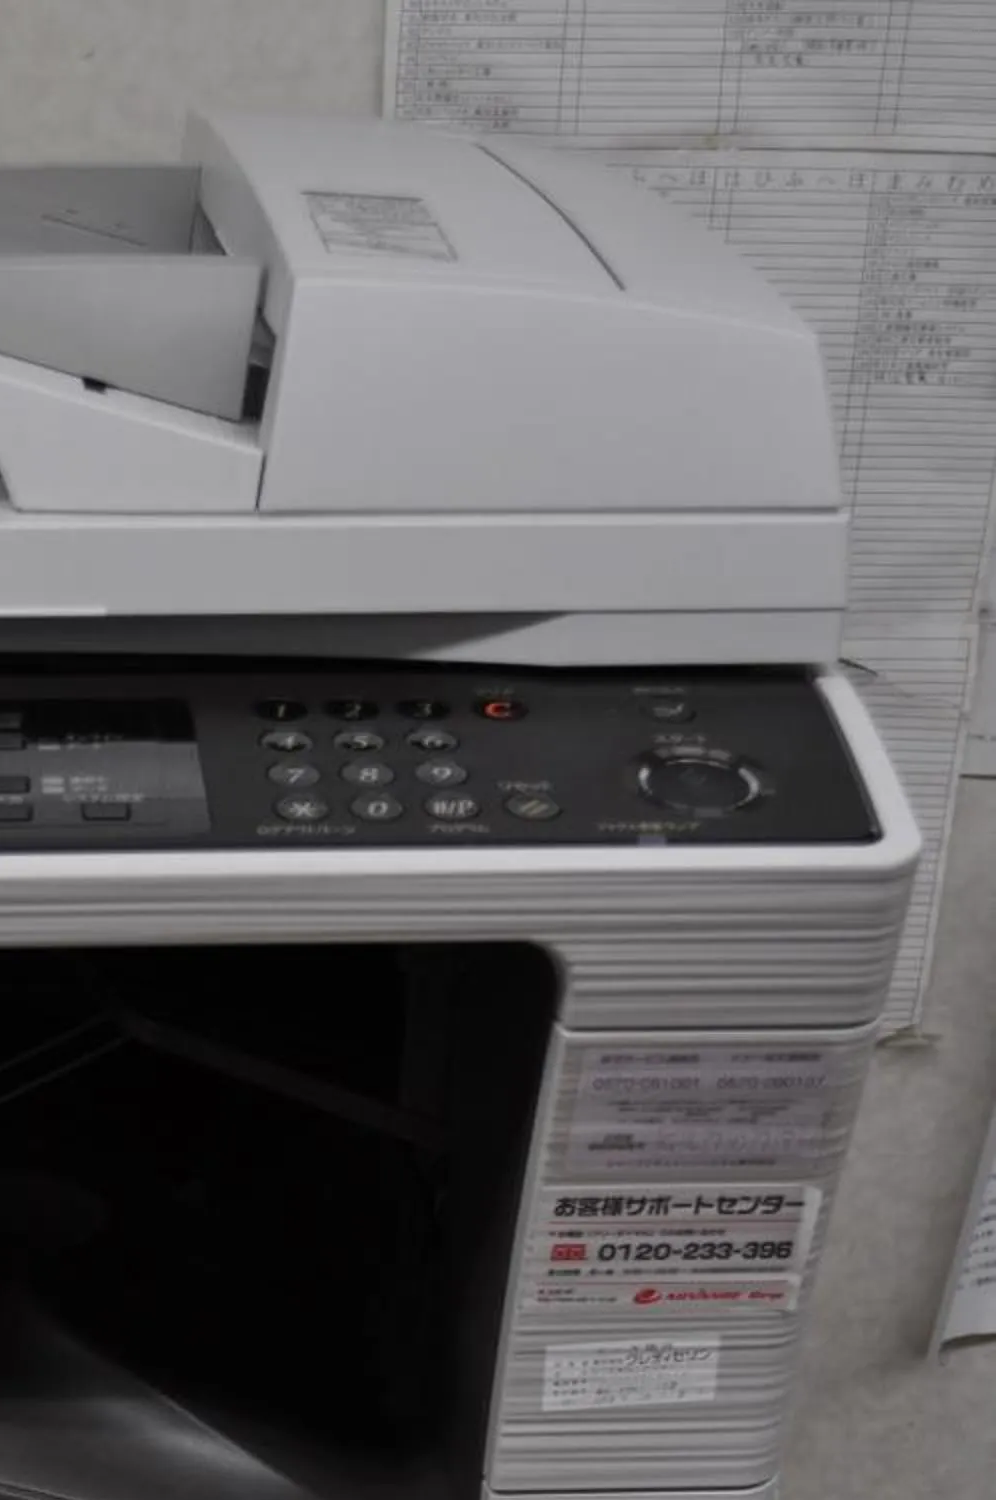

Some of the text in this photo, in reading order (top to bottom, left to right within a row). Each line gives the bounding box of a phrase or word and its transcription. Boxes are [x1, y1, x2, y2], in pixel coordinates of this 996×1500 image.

[484, 703, 511, 718] C
[352, 734, 370, 749] 5
[285, 767, 453, 783] 7 8 9
[367, 800, 389, 816] 0
[553, 1194, 806, 1218] お客様サポートセンター
[597, 1240, 794, 1262] 0120-233-396
